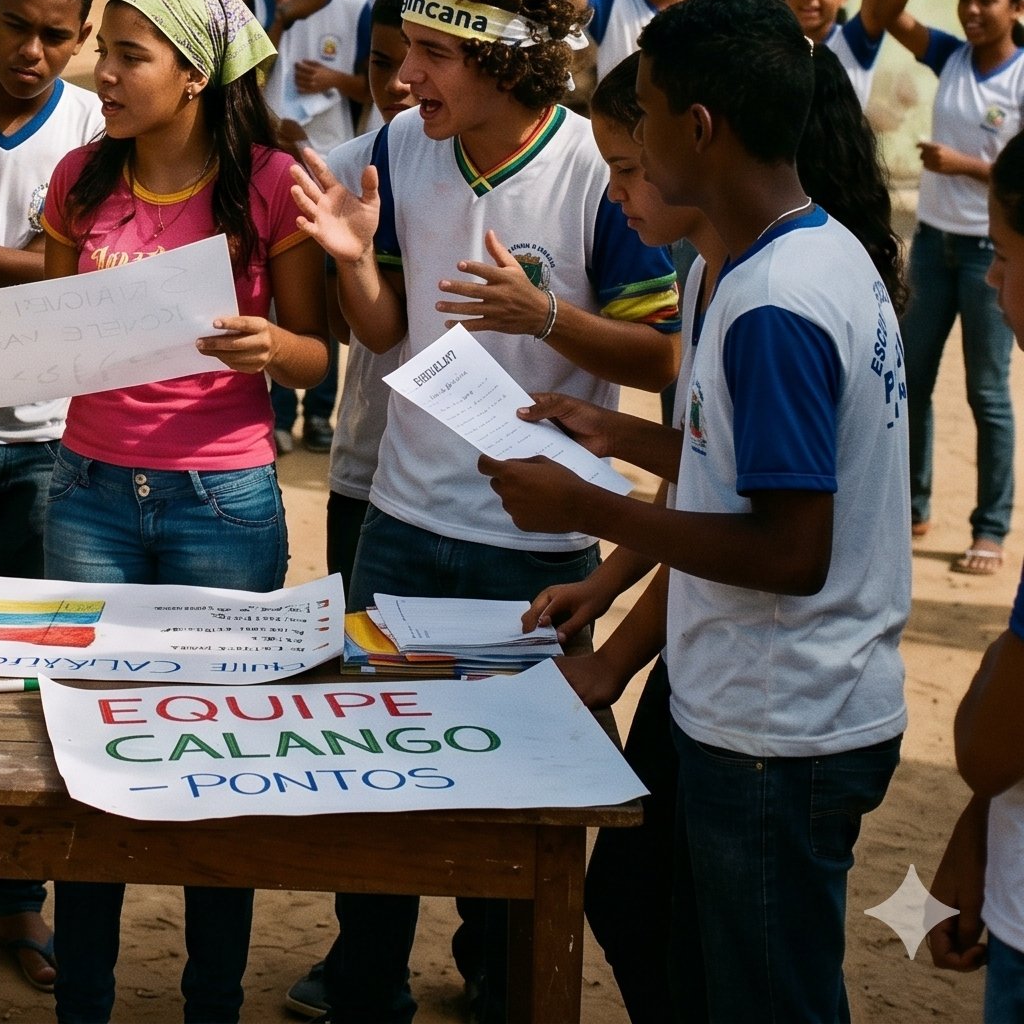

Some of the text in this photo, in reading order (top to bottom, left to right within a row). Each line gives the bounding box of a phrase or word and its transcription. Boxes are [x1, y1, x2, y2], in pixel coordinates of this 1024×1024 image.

[97, 691, 433, 725] EQUIPE
[105, 725, 502, 763] CALANGO
[180, 767, 456, 798] PONTOS
